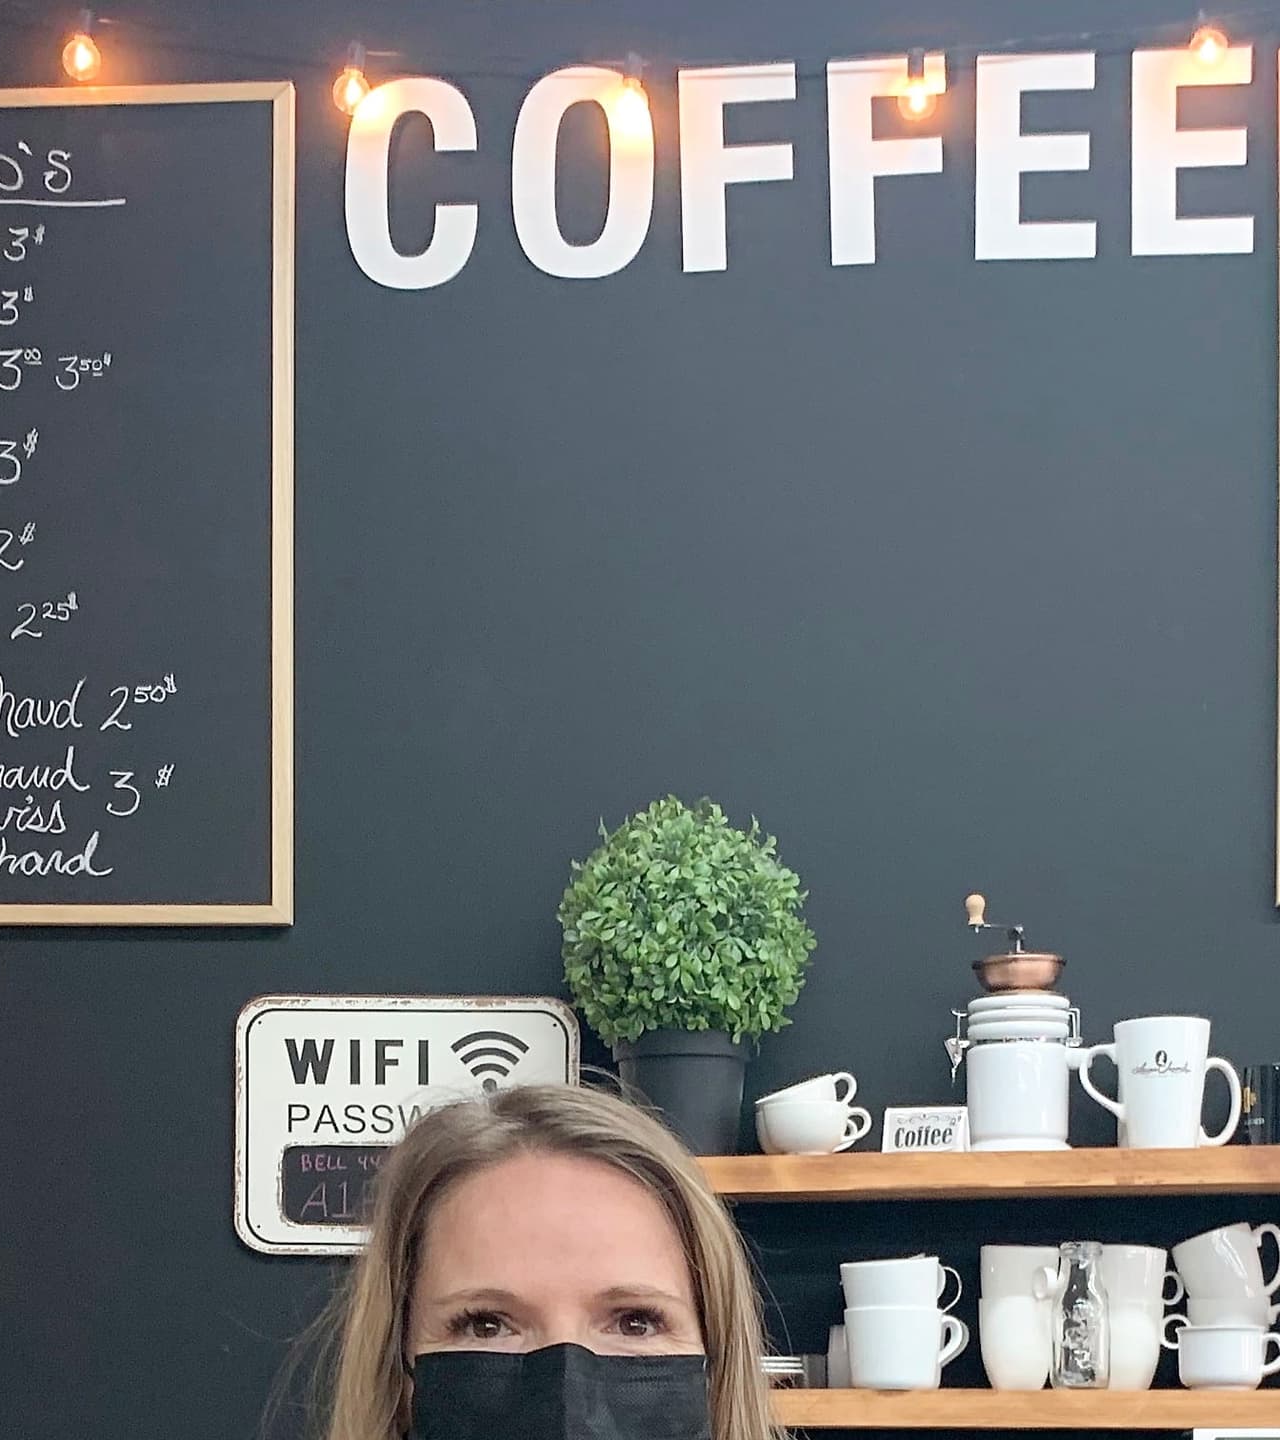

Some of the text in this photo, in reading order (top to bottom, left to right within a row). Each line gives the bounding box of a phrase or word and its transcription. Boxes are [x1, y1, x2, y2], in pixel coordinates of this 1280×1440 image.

[344, 45, 1254, 290] COFFEE
[284, 1039, 429, 1085] WIFI
[287, 1104, 426, 1134] PASSW
[894, 1125, 953, 1149] Coffee
[301, 1153, 347, 1172] BELL
